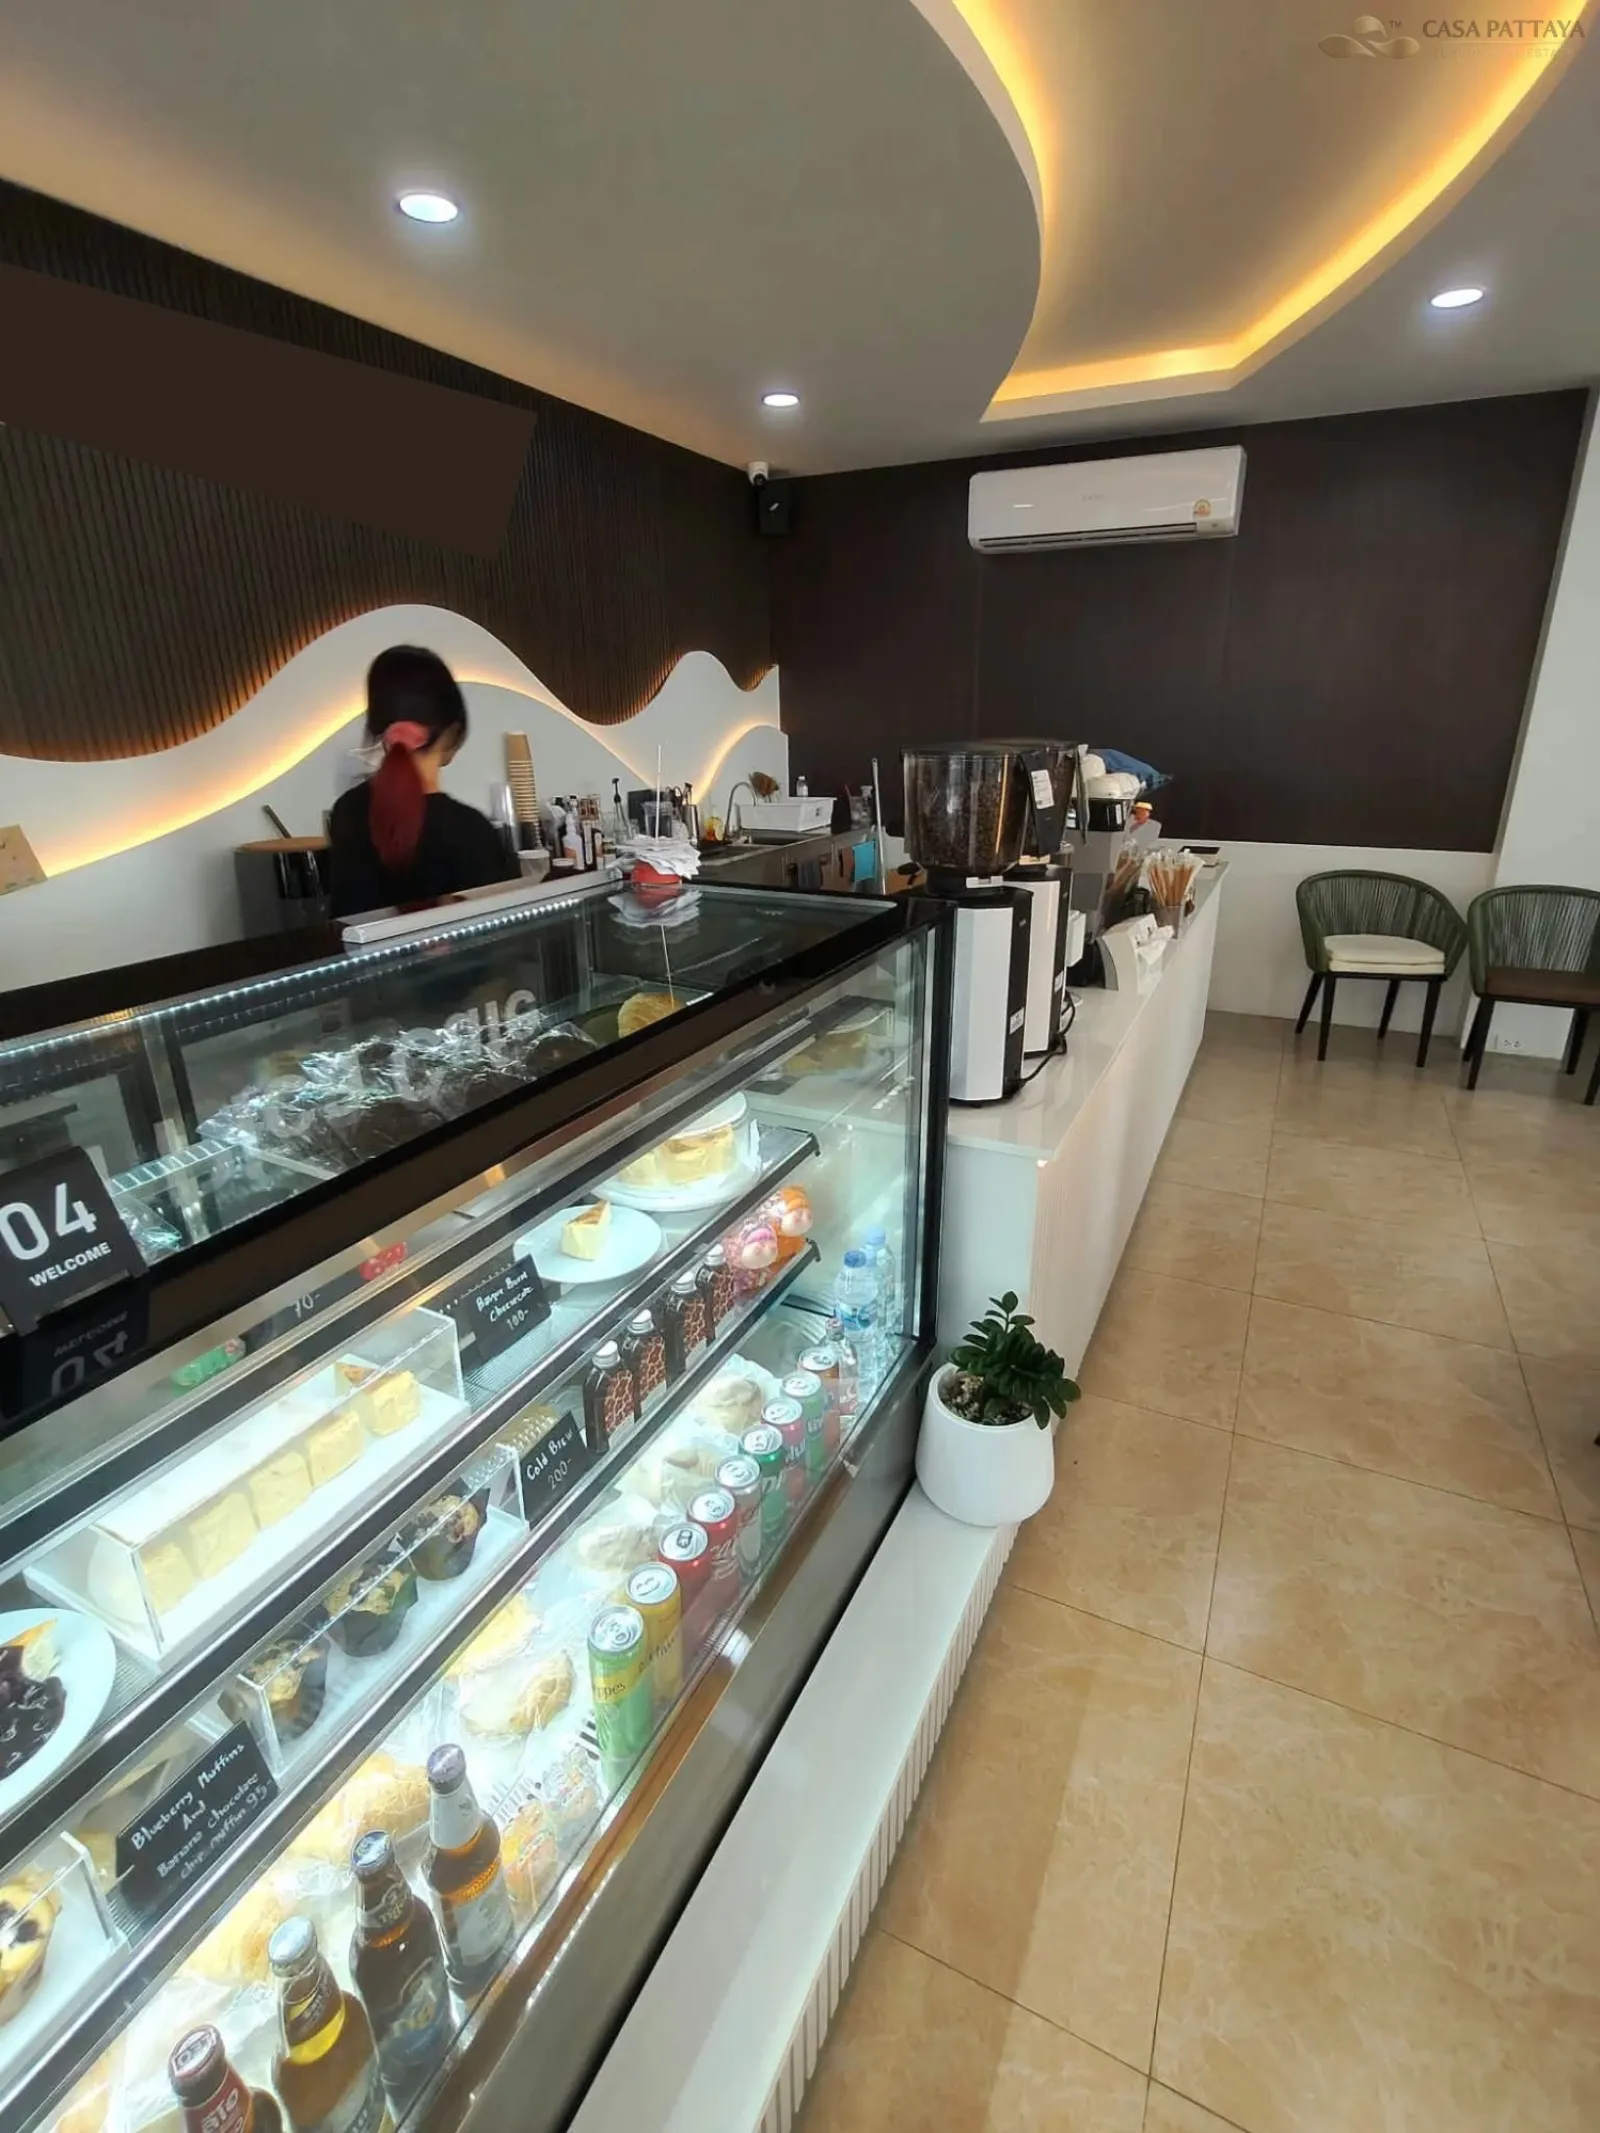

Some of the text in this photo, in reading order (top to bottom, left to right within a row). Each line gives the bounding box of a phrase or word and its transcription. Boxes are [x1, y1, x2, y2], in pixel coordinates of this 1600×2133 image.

[0, 1183, 97, 1260] 04
[29, 1241, 112, 1287] WELCOME
[526, 1452, 549, 1480] Cold
[131, 1743, 245, 1850] Blueberry Muffins
[182, 1800, 206, 1830] And
